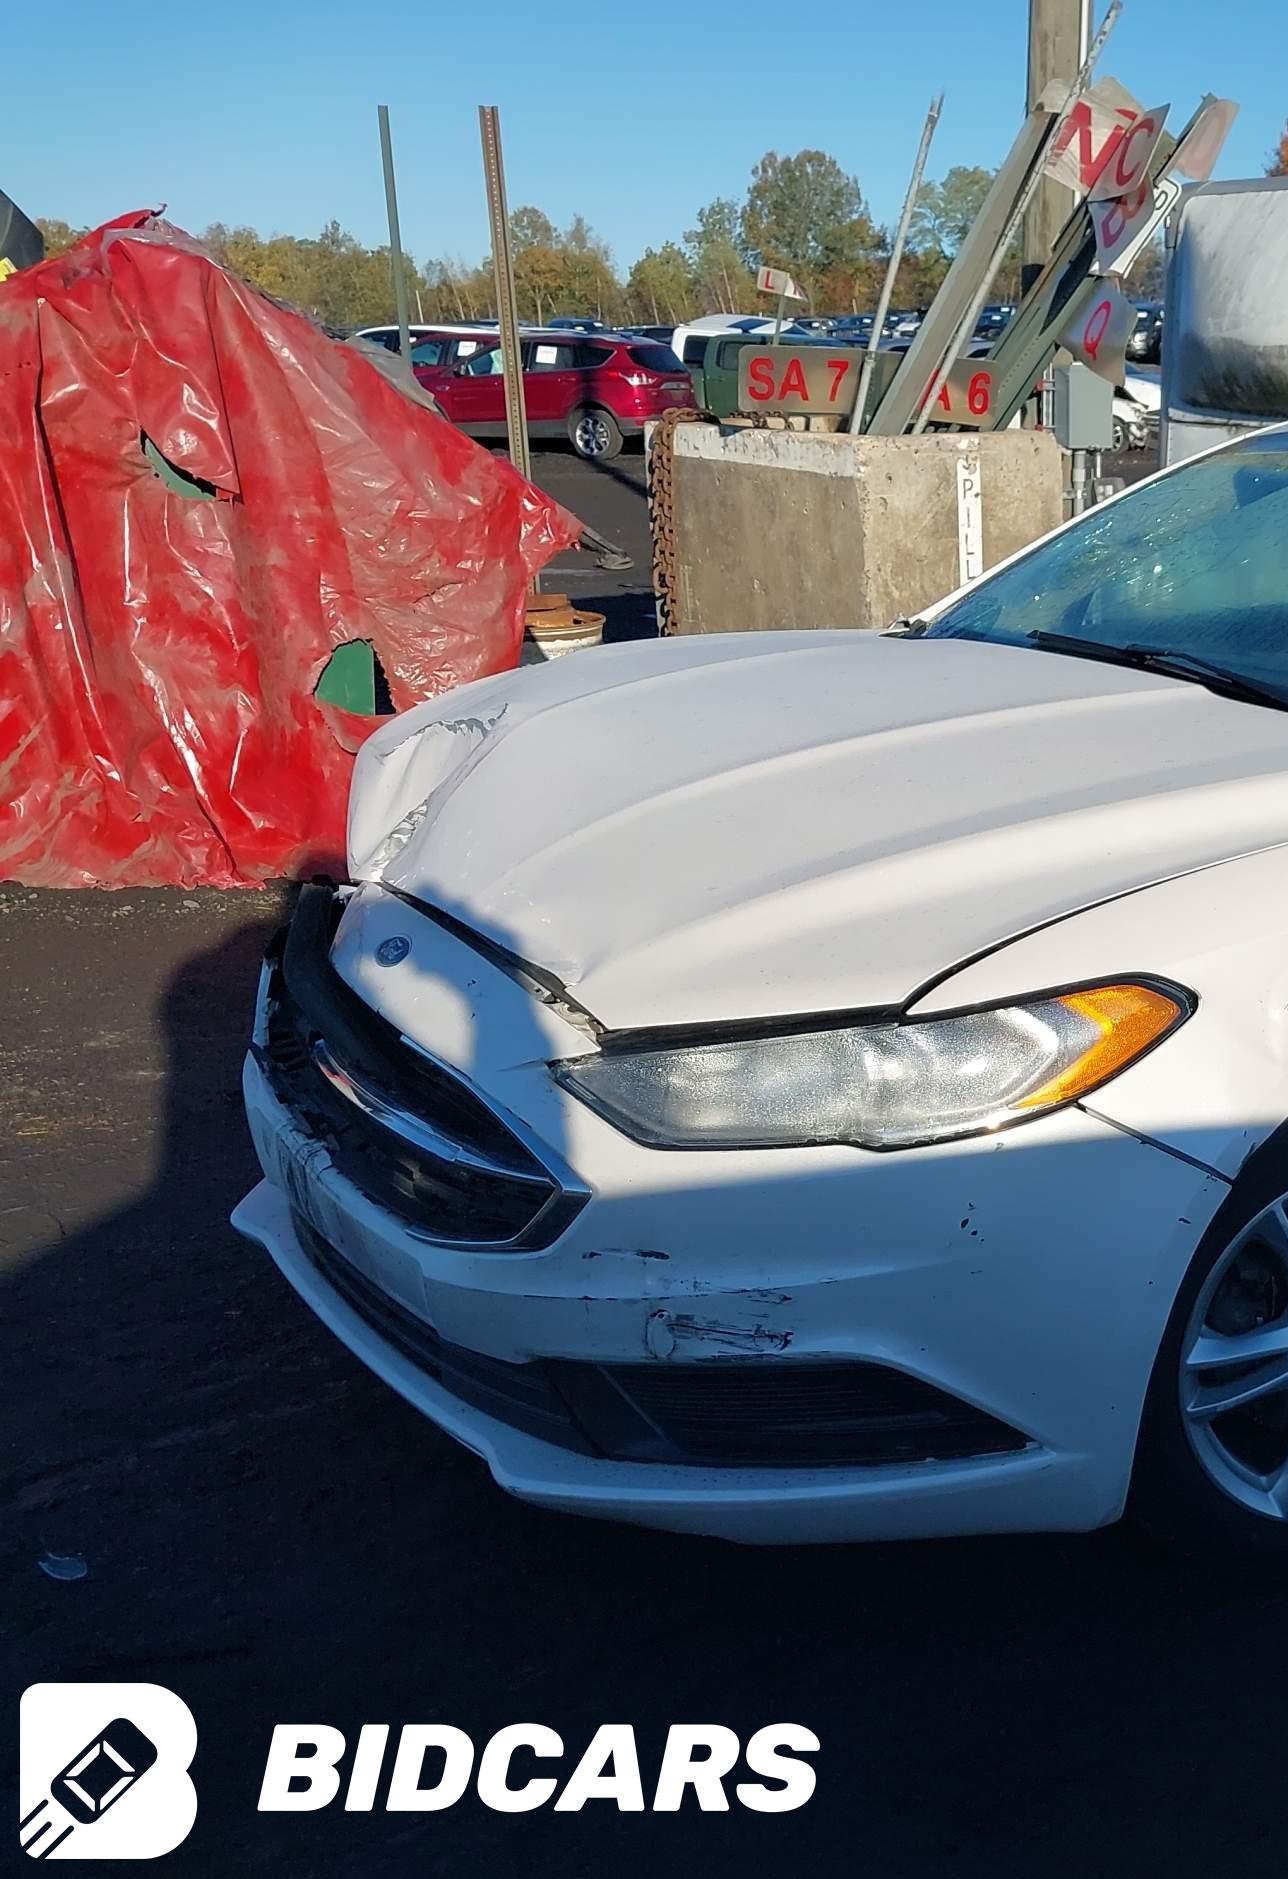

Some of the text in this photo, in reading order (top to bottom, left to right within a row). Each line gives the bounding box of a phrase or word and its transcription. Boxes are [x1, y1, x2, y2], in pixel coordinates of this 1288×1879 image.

[747, 356, 849, 402] SA 7
[967, 370, 992, 416] 6
